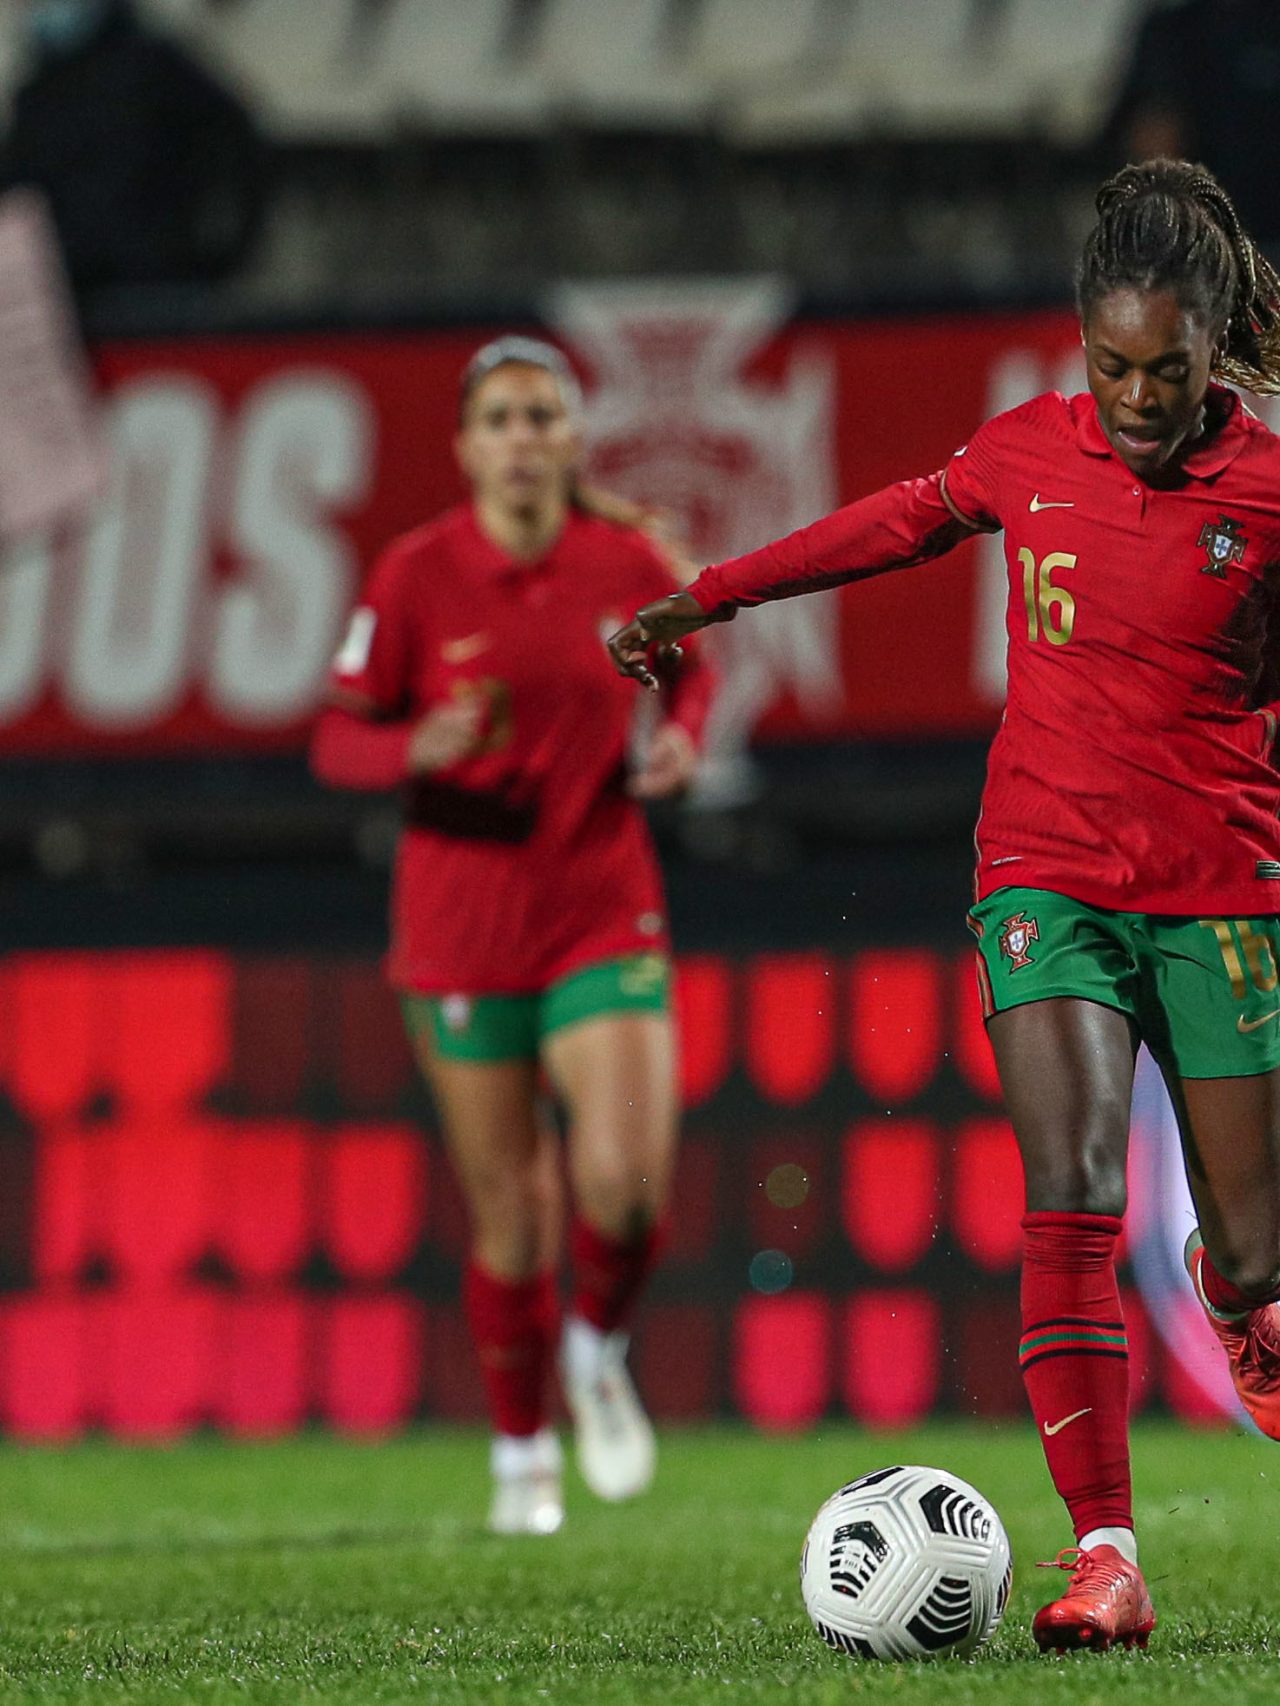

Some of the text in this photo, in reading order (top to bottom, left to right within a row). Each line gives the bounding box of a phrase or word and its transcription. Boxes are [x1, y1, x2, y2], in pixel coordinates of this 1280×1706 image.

[0, 370, 376, 728] OS
[1017, 546, 1077, 645] 16
[1200, 920, 1278, 1000] 16
